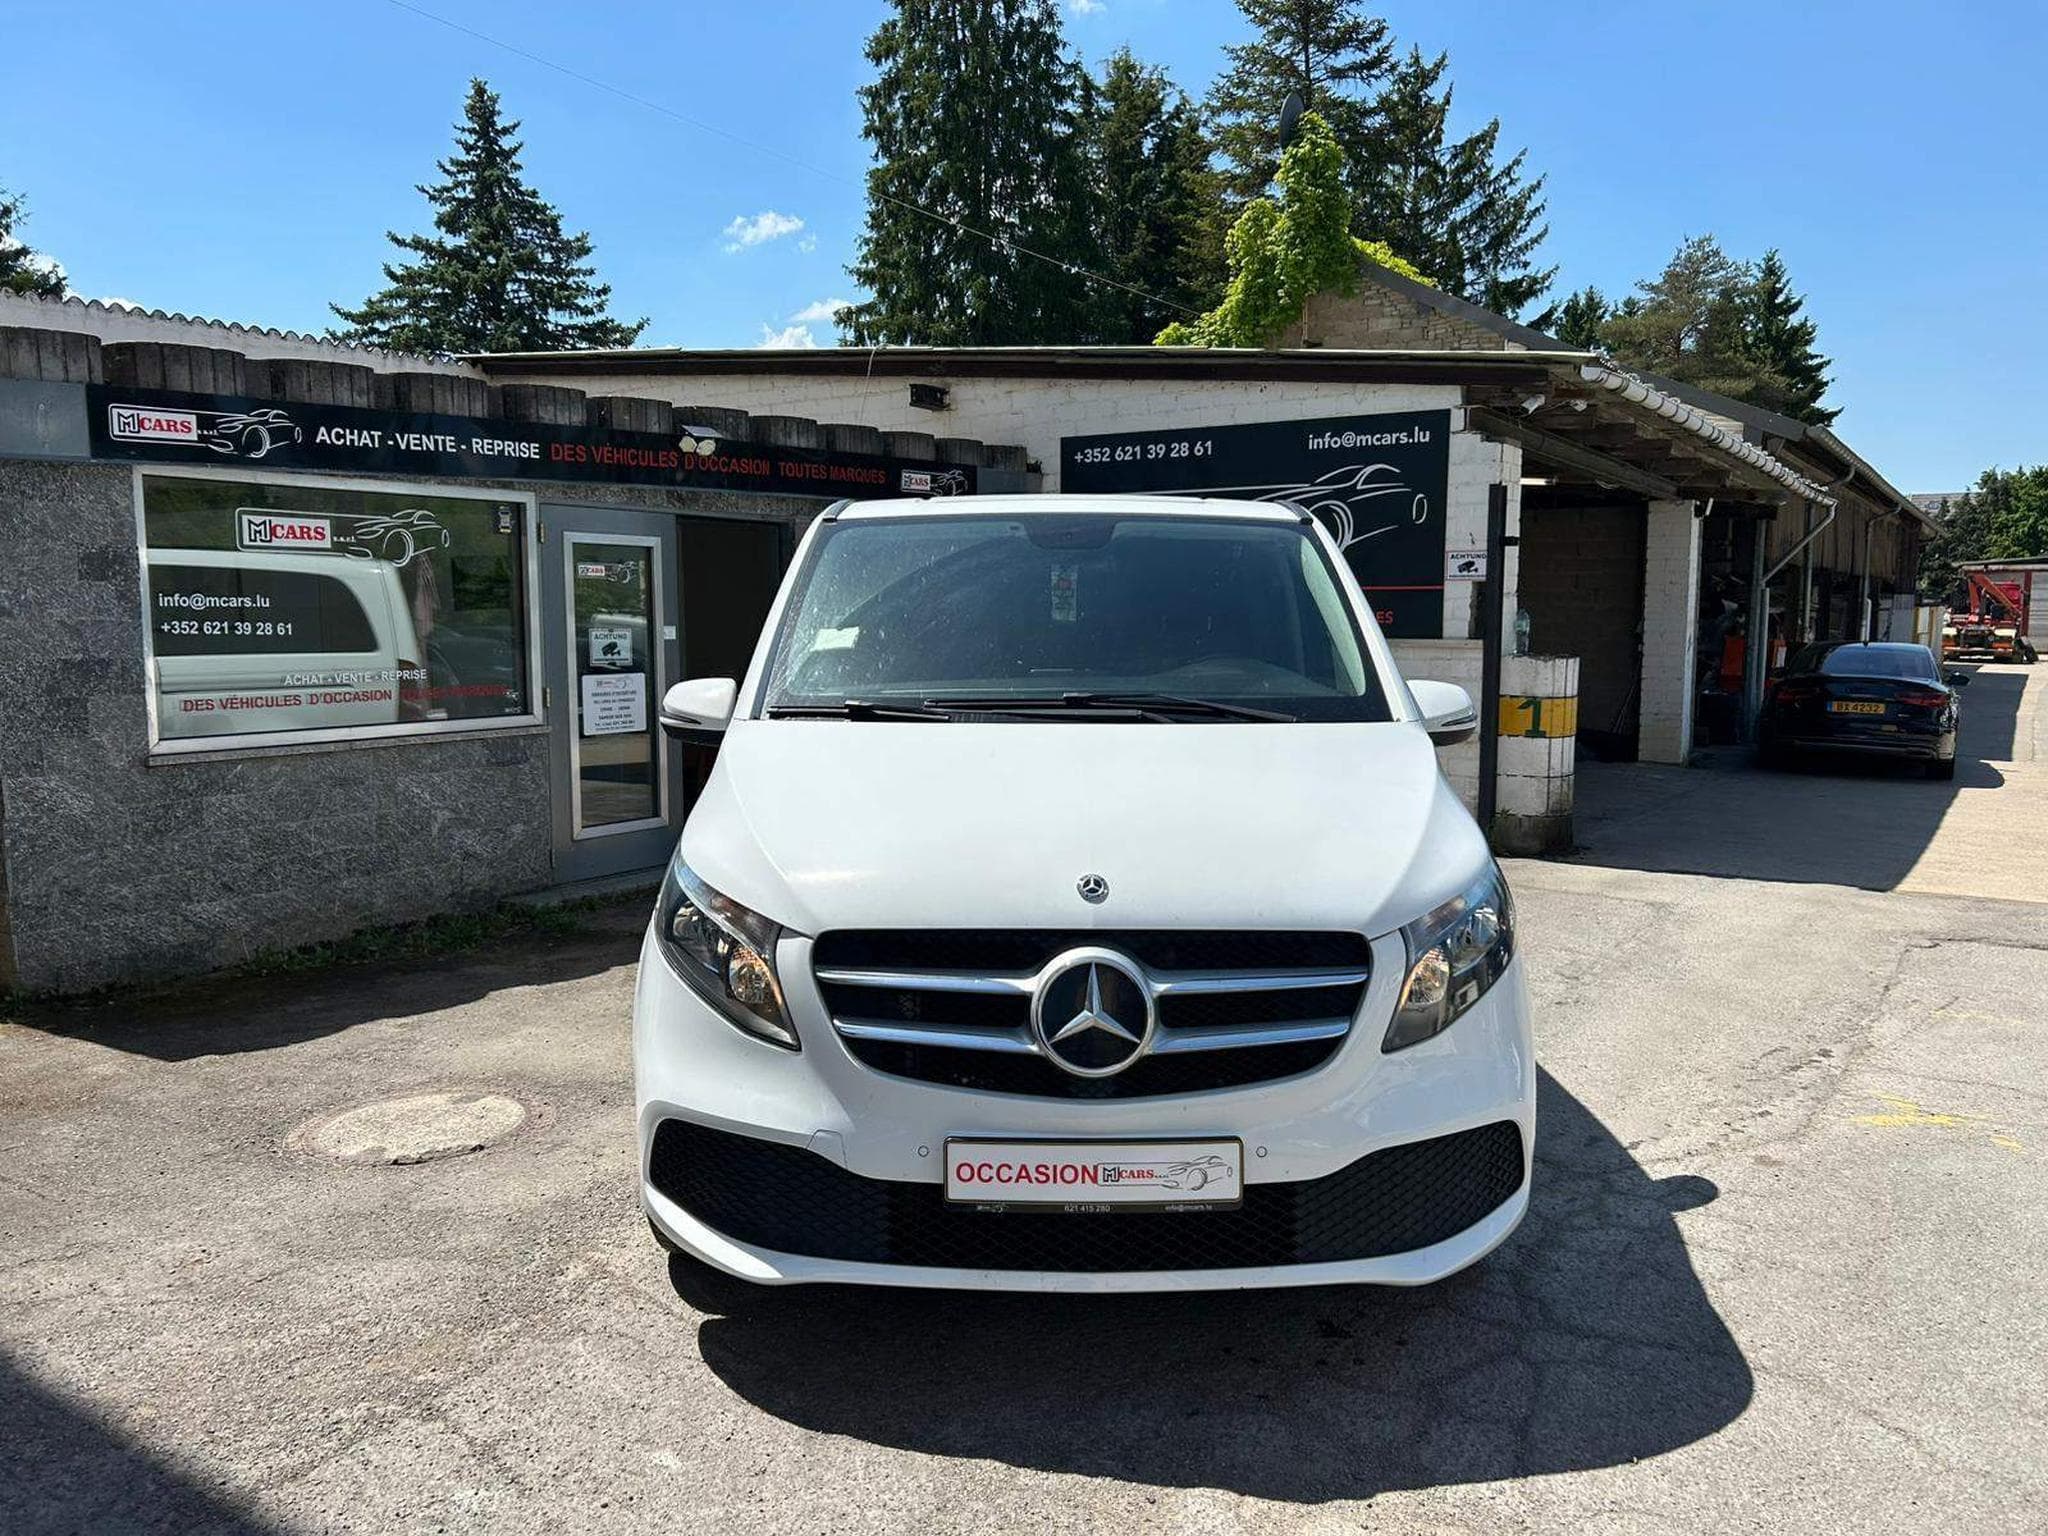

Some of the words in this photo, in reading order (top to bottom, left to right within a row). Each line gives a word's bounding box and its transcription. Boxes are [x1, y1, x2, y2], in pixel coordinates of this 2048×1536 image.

[315, 426, 382, 448] ACHAT
[472, 438, 541, 459] REPRISE
[1308, 426, 1430, 450] info@mcars.lu
[1074, 447, 1111, 463] +352
[1115, 445, 1141, 461] 621
[1147, 443, 1166, 459] 39
[1170, 442, 1190, 458] 28
[1194, 440, 1213, 456] 61
[551, 443, 587, 462] DES
[684, 453, 770, 476] D'OCCASION
[778, 461, 828, 480] TOUTES
[830, 465, 887, 485] MARQUES
[158, 593, 270, 610] info@mcars.lu
[161, 620, 199, 635] +352
[203, 621, 229, 635] 621
[234, 622, 252, 635] 39
[255, 622, 273, 635] 28
[277, 622, 293, 635] 61
[283, 673, 323, 686] ACHAT
[334, 671, 371, 685] VENTE
[381, 669, 427, 682] REPRISE
[182, 699, 215, 712] DES
[308, 690, 392, 706] D'OCCASION
[1516, 698, 1547, 738] 1
[956, 1162, 1099, 1184] OCCASION
